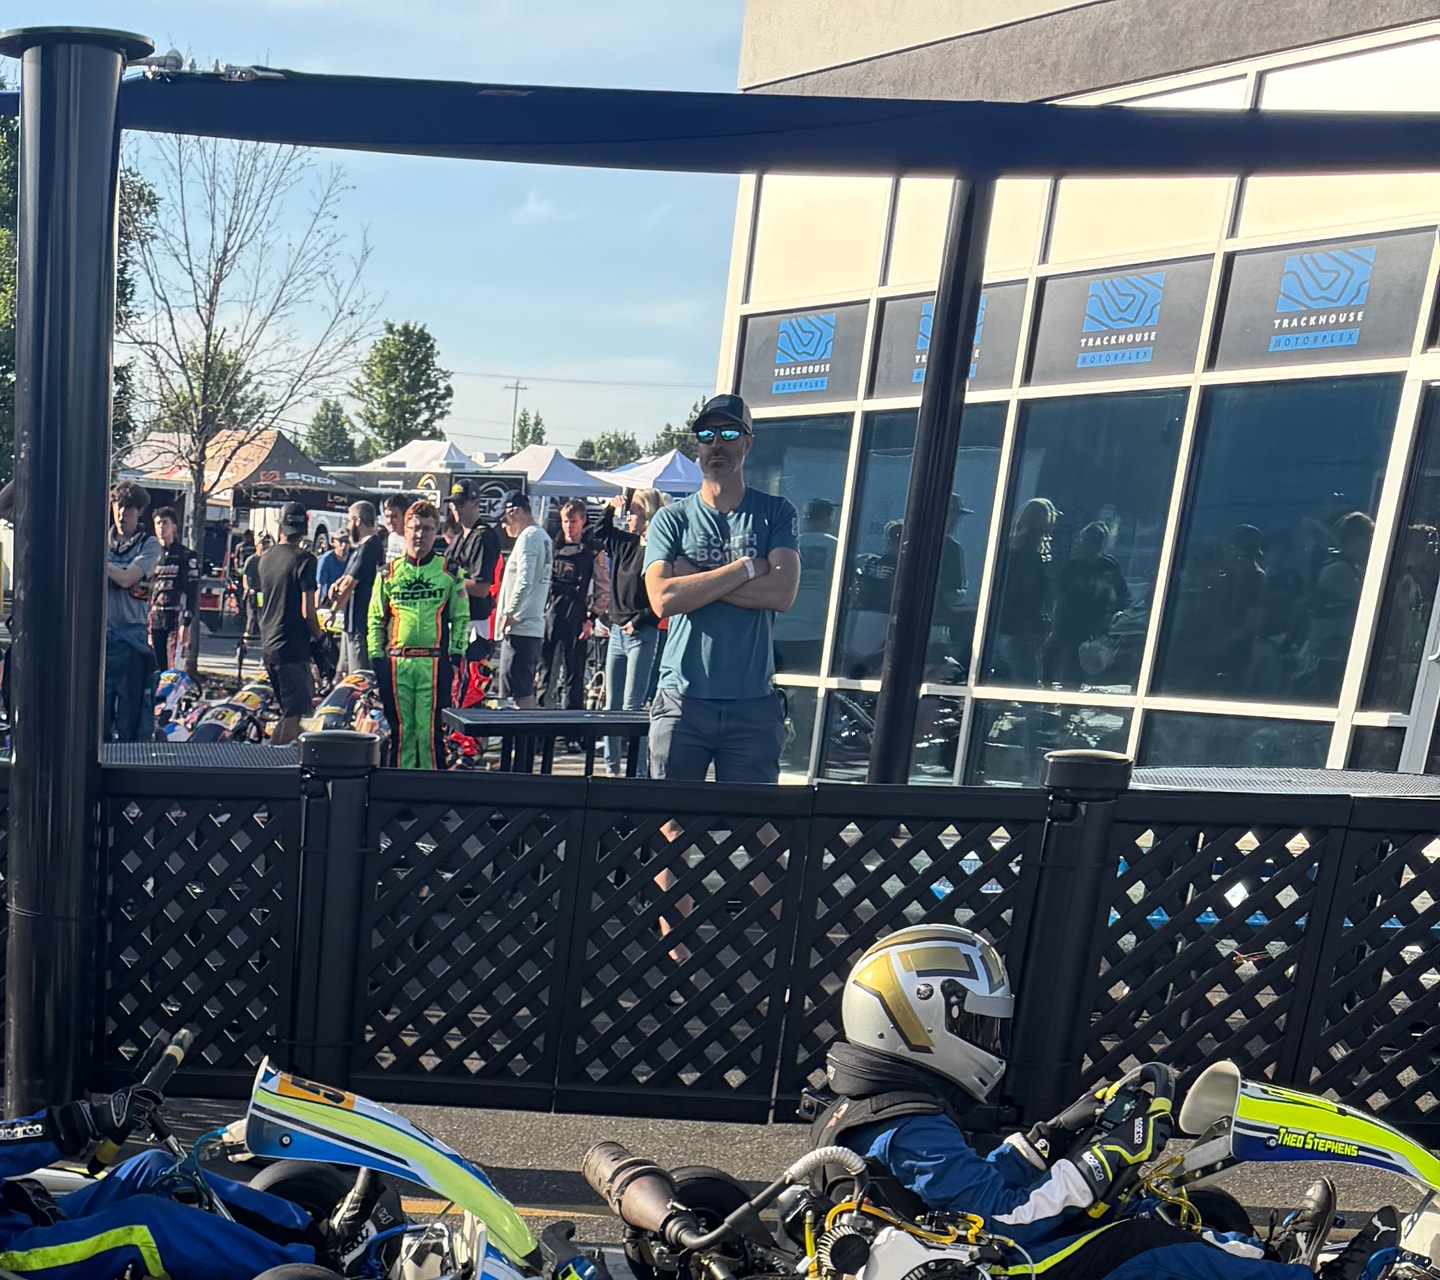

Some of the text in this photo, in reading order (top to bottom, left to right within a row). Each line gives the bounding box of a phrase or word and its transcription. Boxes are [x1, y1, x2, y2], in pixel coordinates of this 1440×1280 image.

[1273, 312, 1364, 329] TRACKHOUSE
[1080, 331, 1157, 347] TRACKHOUSE
[1274, 332, 1355, 348] MOTORPLEX
[1080, 351, 1149, 364] MOTORPLEX
[774, 364, 831, 377] TRACKHOUSE
